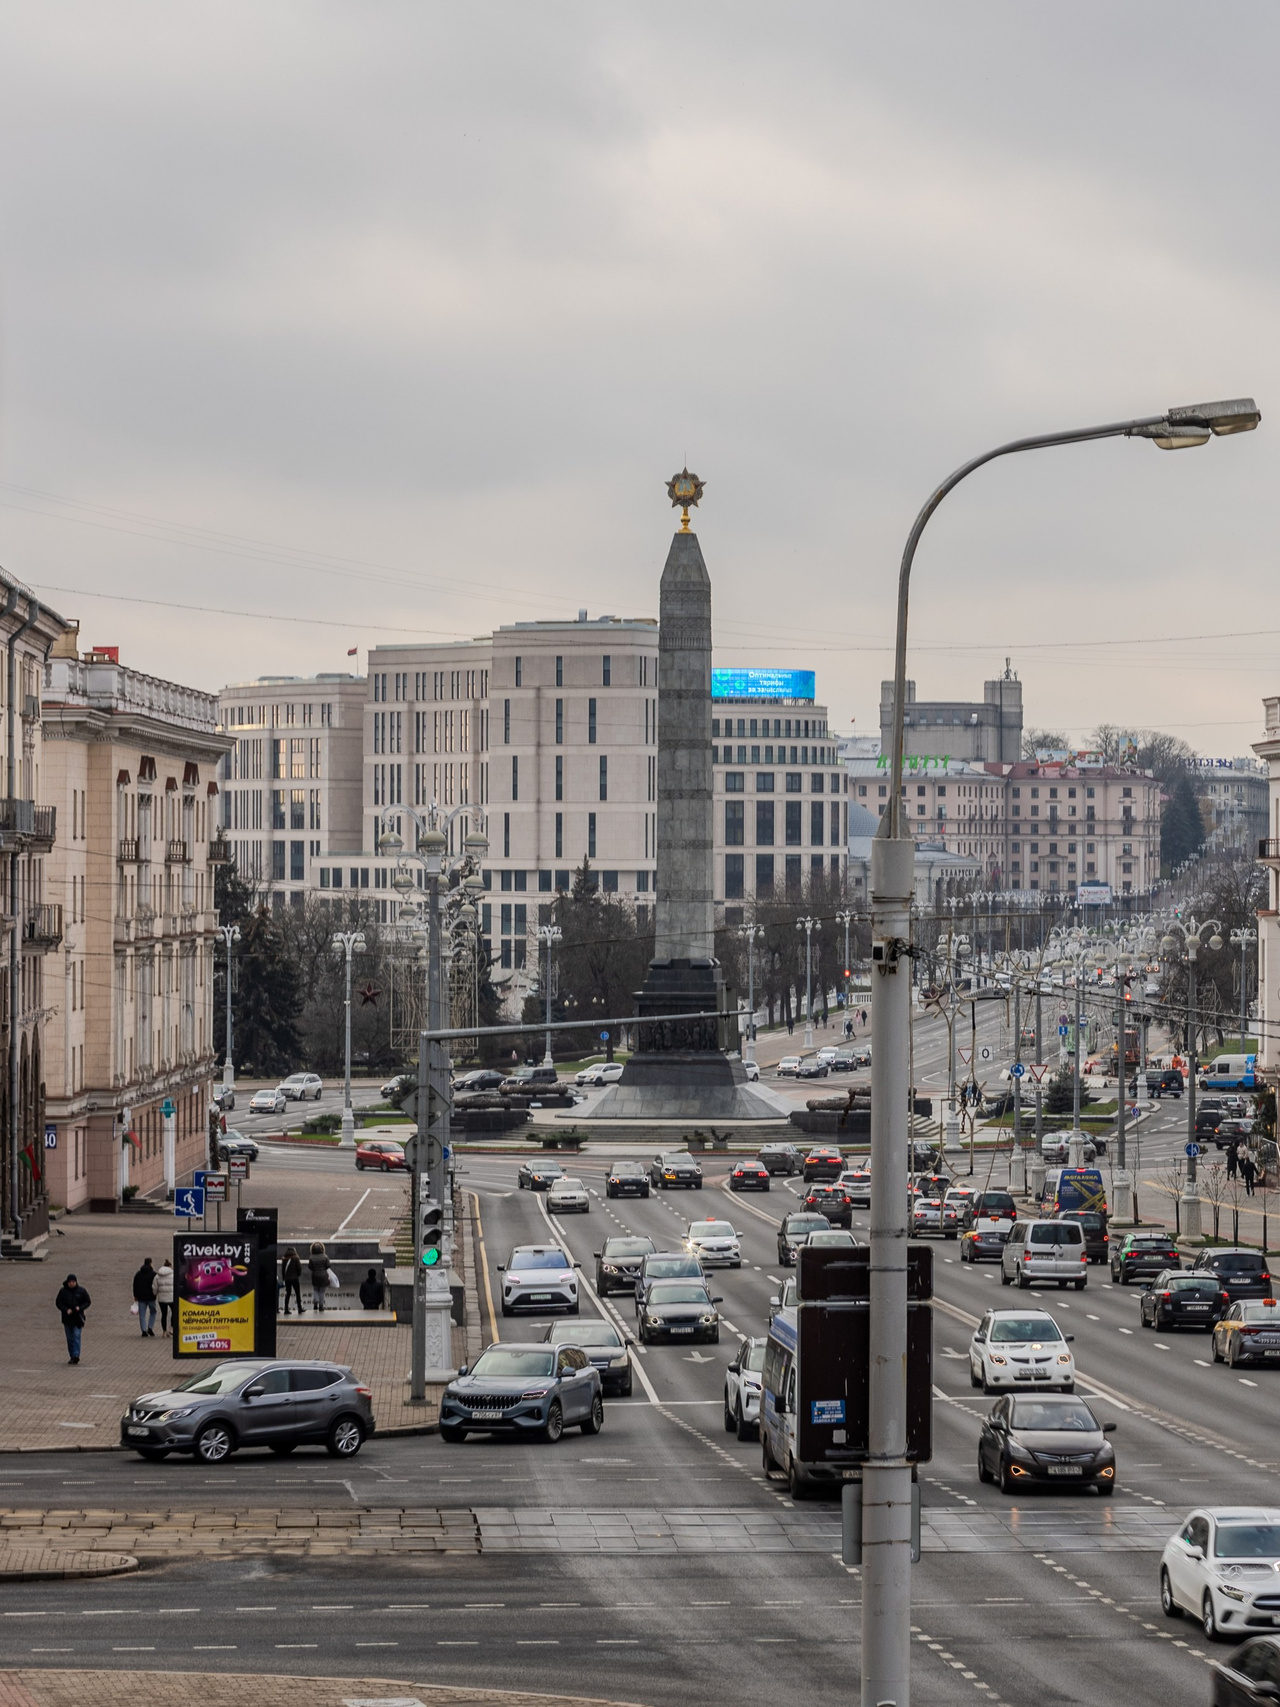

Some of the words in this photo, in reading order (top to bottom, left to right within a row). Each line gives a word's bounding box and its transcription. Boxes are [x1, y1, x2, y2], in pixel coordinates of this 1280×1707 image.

[183, 1243, 242, 1258] 21vek.by
[182, 1310, 220, 1318] КОМАНДА
[209, 1341, 228, 1349] 40%
